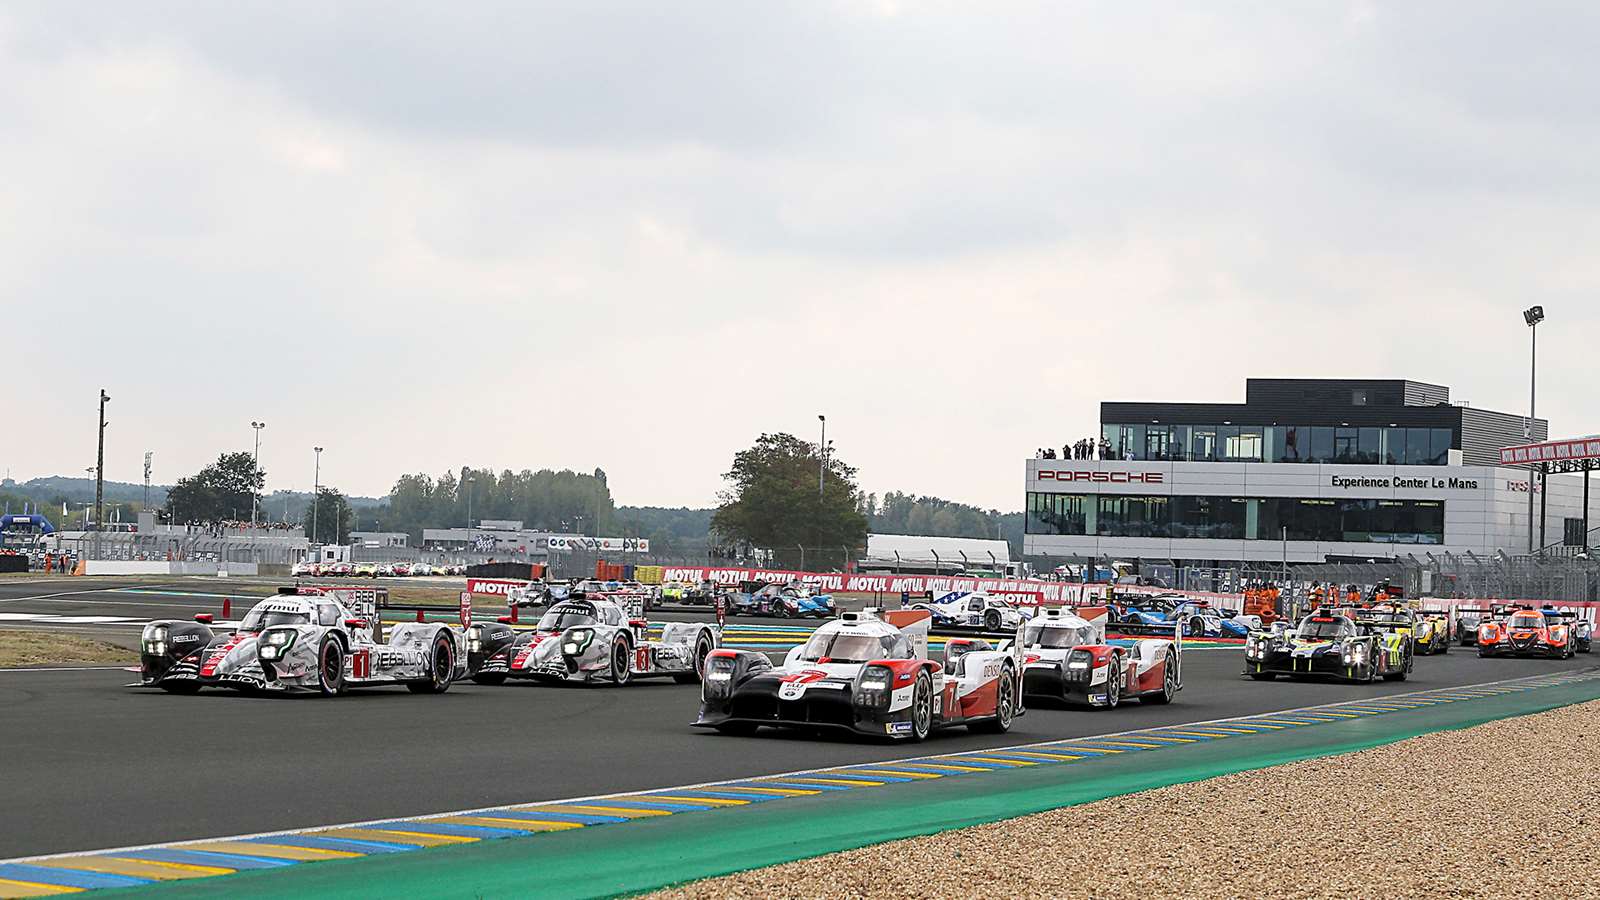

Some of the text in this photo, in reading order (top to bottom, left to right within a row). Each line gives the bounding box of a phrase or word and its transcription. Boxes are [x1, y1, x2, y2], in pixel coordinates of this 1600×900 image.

[1038, 470, 1163, 483] PORSCHE
[1332, 475, 1477, 489] Experience Center Le Mans
[664, 569, 705, 582] MOTUL
[708, 570, 748, 583] MOTUL
[801, 575, 842, 590] MOTUL
[847, 577, 886, 591] MOTUL
[891, 578, 924, 592] MOTUL
[994, 592, 1038, 604] MOTUL
[344, 653, 353, 668] P1
[358, 655, 365, 677] 1
[376, 652, 434, 668] REBELLION
